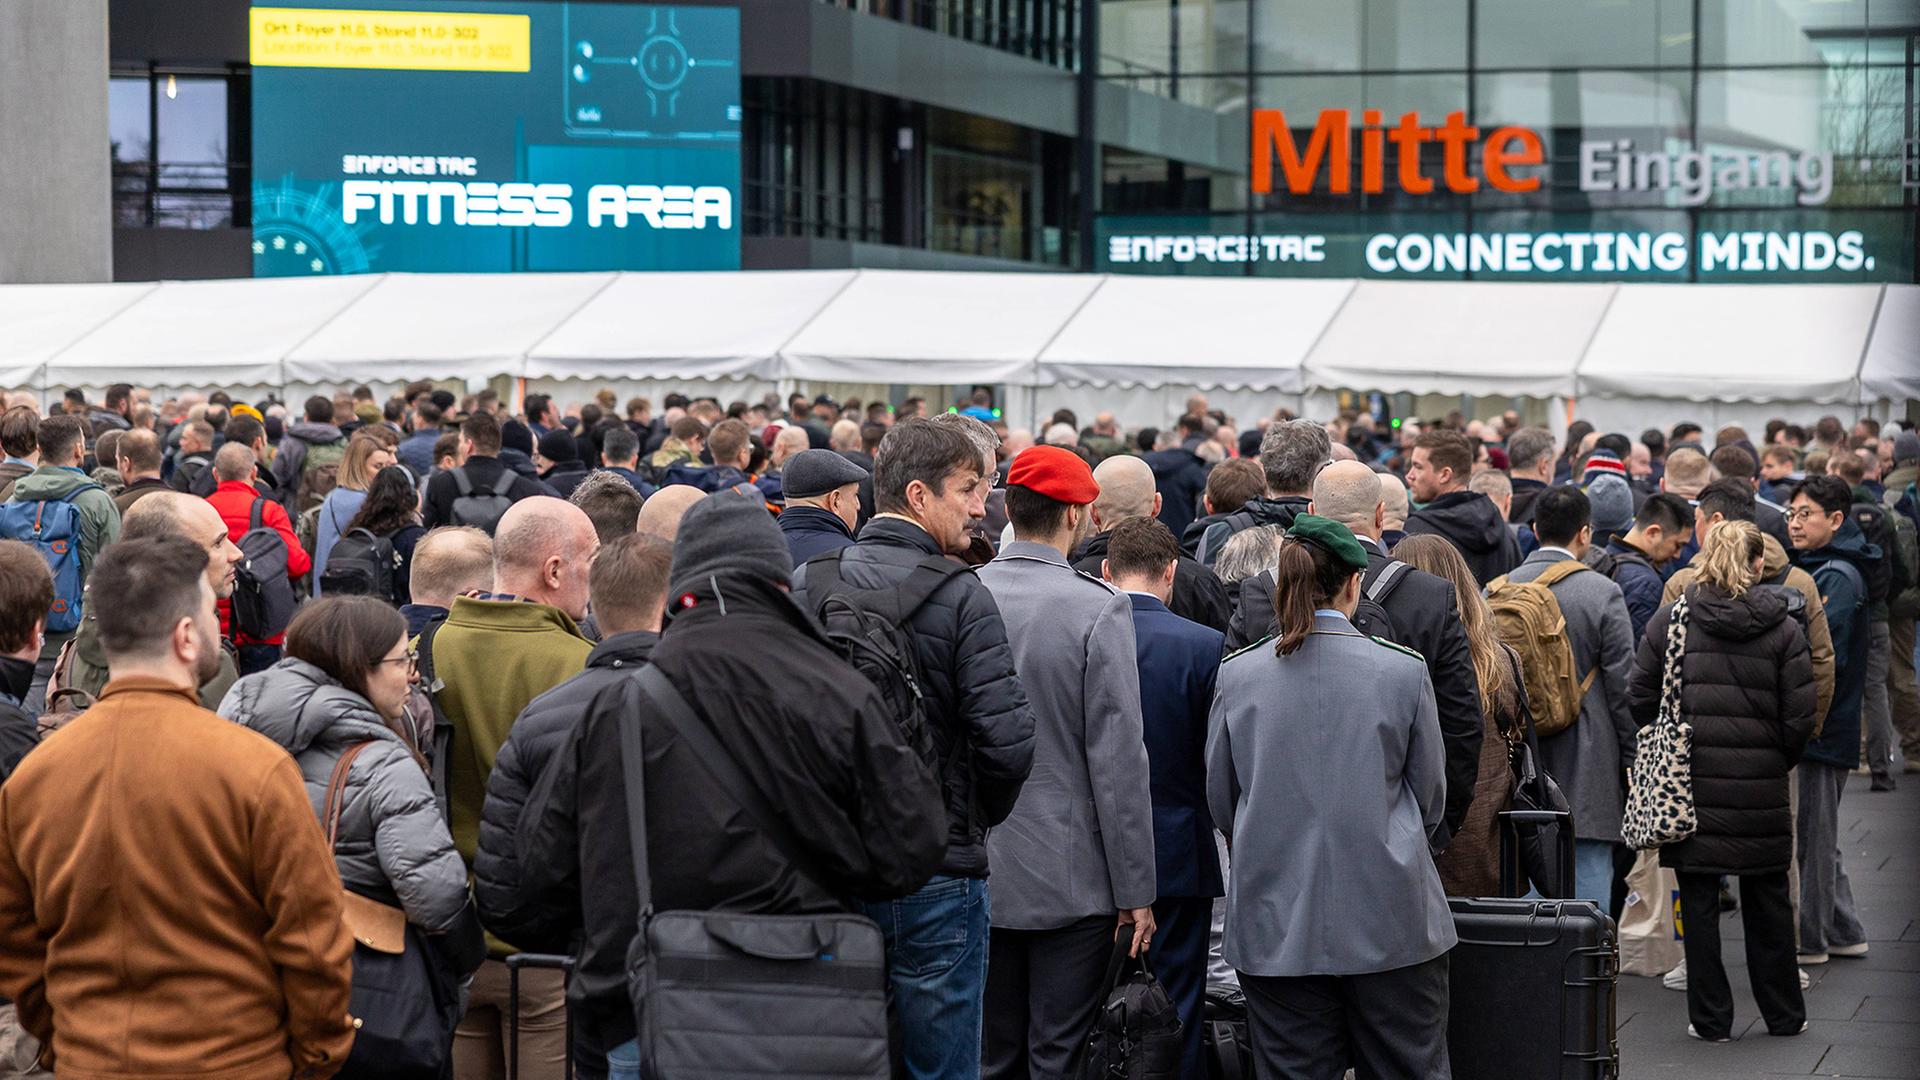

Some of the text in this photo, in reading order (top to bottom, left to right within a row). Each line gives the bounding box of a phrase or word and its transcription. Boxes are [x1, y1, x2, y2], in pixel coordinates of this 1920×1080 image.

[296, 23, 335, 39] Foyer
[374, 24, 416, 38] Stand
[1251, 108, 1545, 194] Mitte
[1579, 138, 1834, 206] Eingang
[342, 180, 732, 229] FITNESS AREA
[1365, 231, 1689, 273] CONNECTING
[1700, 230, 1875, 272] MINDS.
